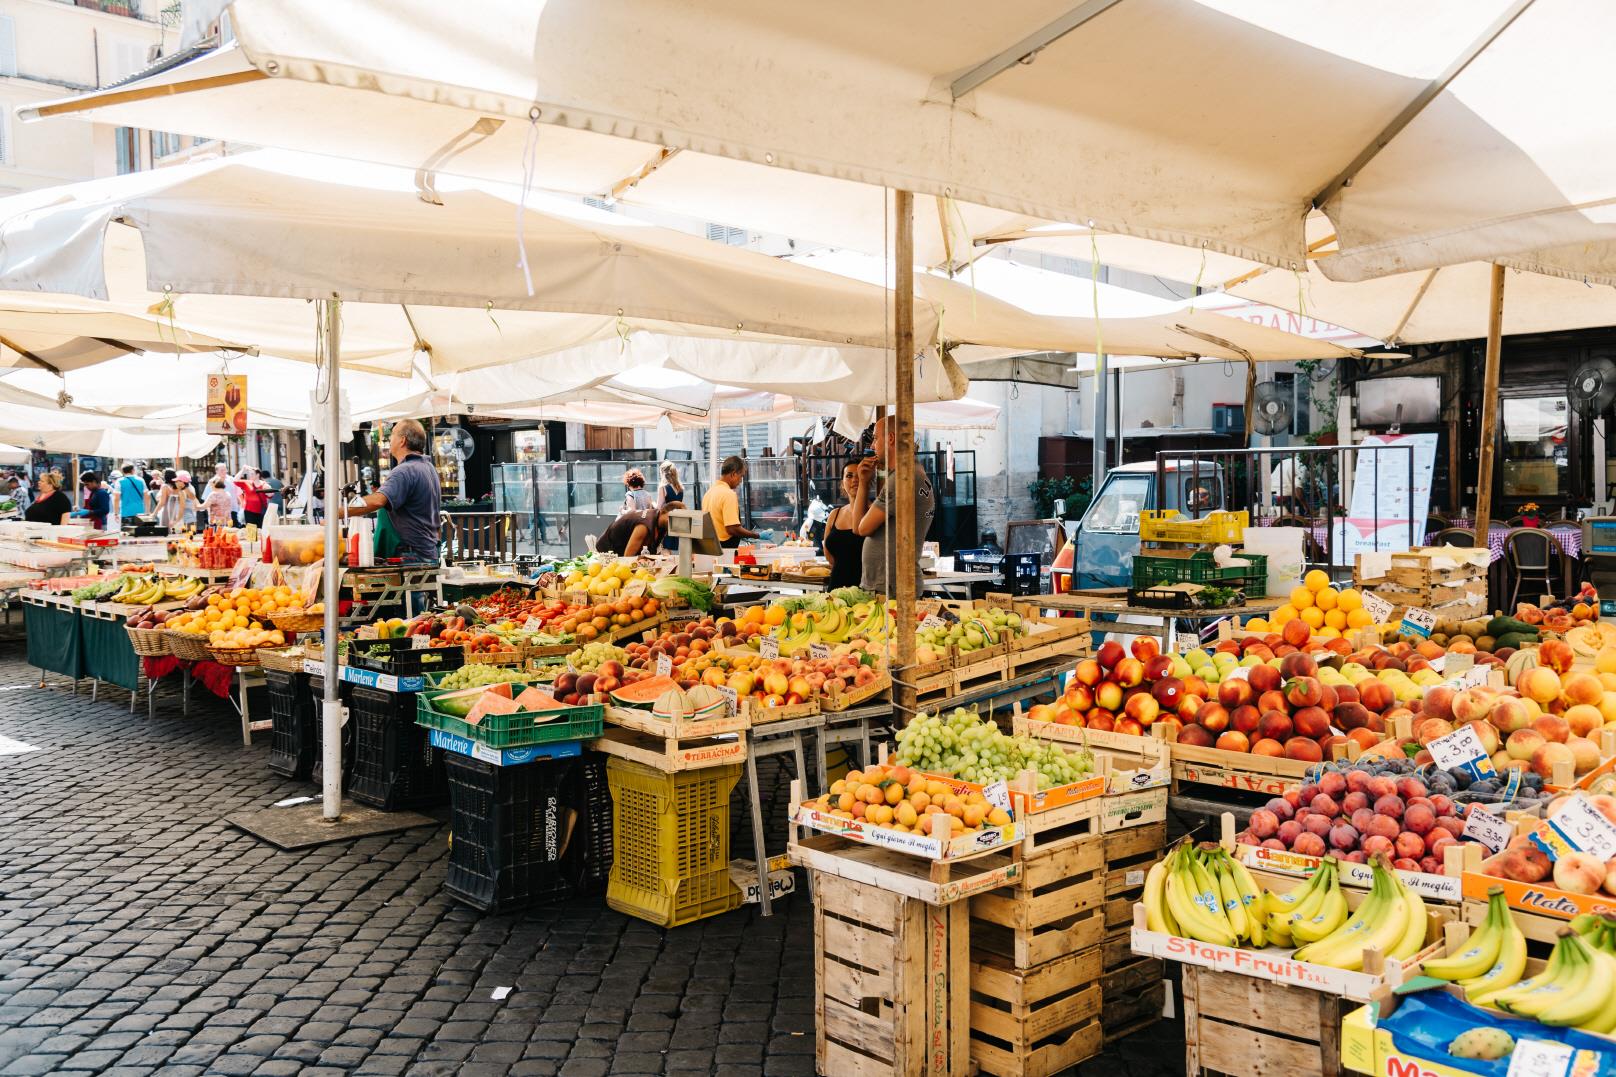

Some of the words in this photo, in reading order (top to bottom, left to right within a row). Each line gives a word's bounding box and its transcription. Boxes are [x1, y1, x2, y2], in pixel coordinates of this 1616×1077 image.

[347, 668, 374, 686] Marlene
[434, 731, 468, 754] Marlene
[691, 748, 736, 760] TERRACINA
[811, 810, 863, 832] diamante
[1521, 890, 1578, 914] Nata
